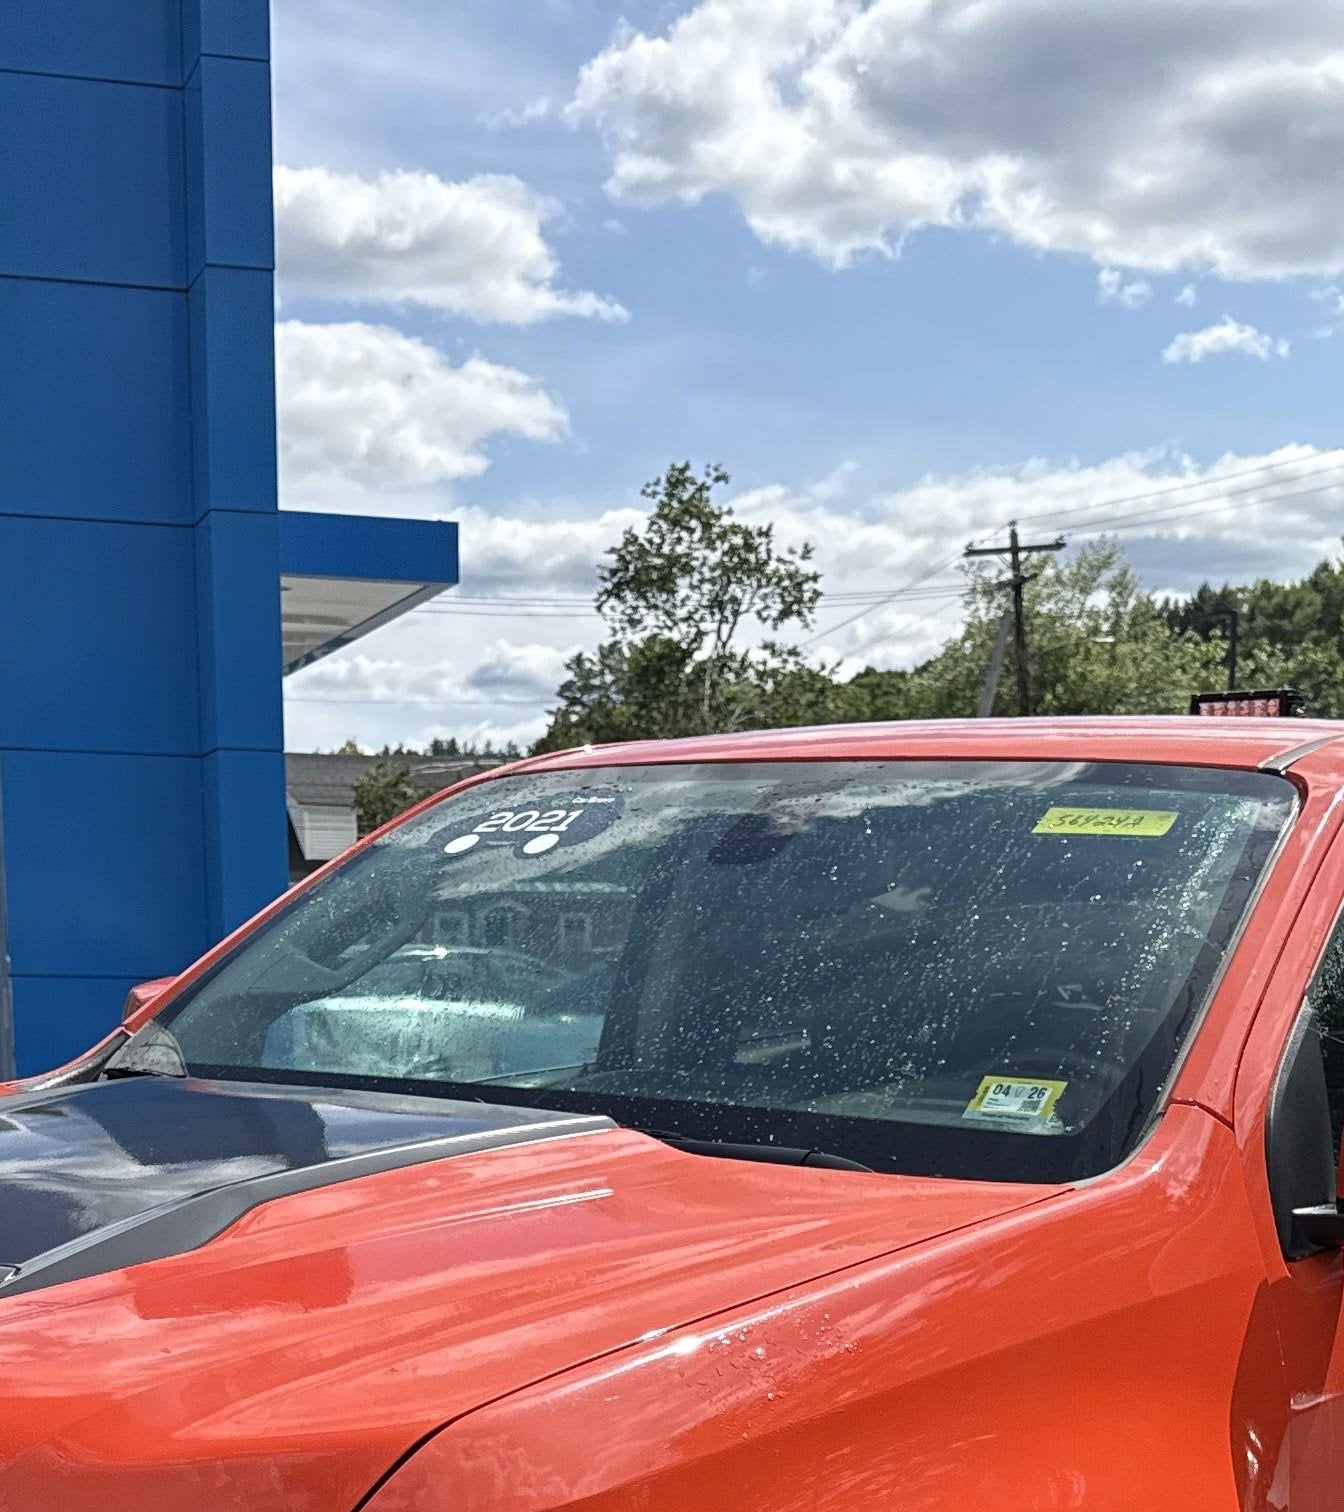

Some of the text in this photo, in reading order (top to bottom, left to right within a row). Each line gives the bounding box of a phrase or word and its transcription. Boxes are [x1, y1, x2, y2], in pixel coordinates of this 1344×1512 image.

[472, 809, 584, 833] 2021
[993, 1083, 1049, 1100] 04 26
